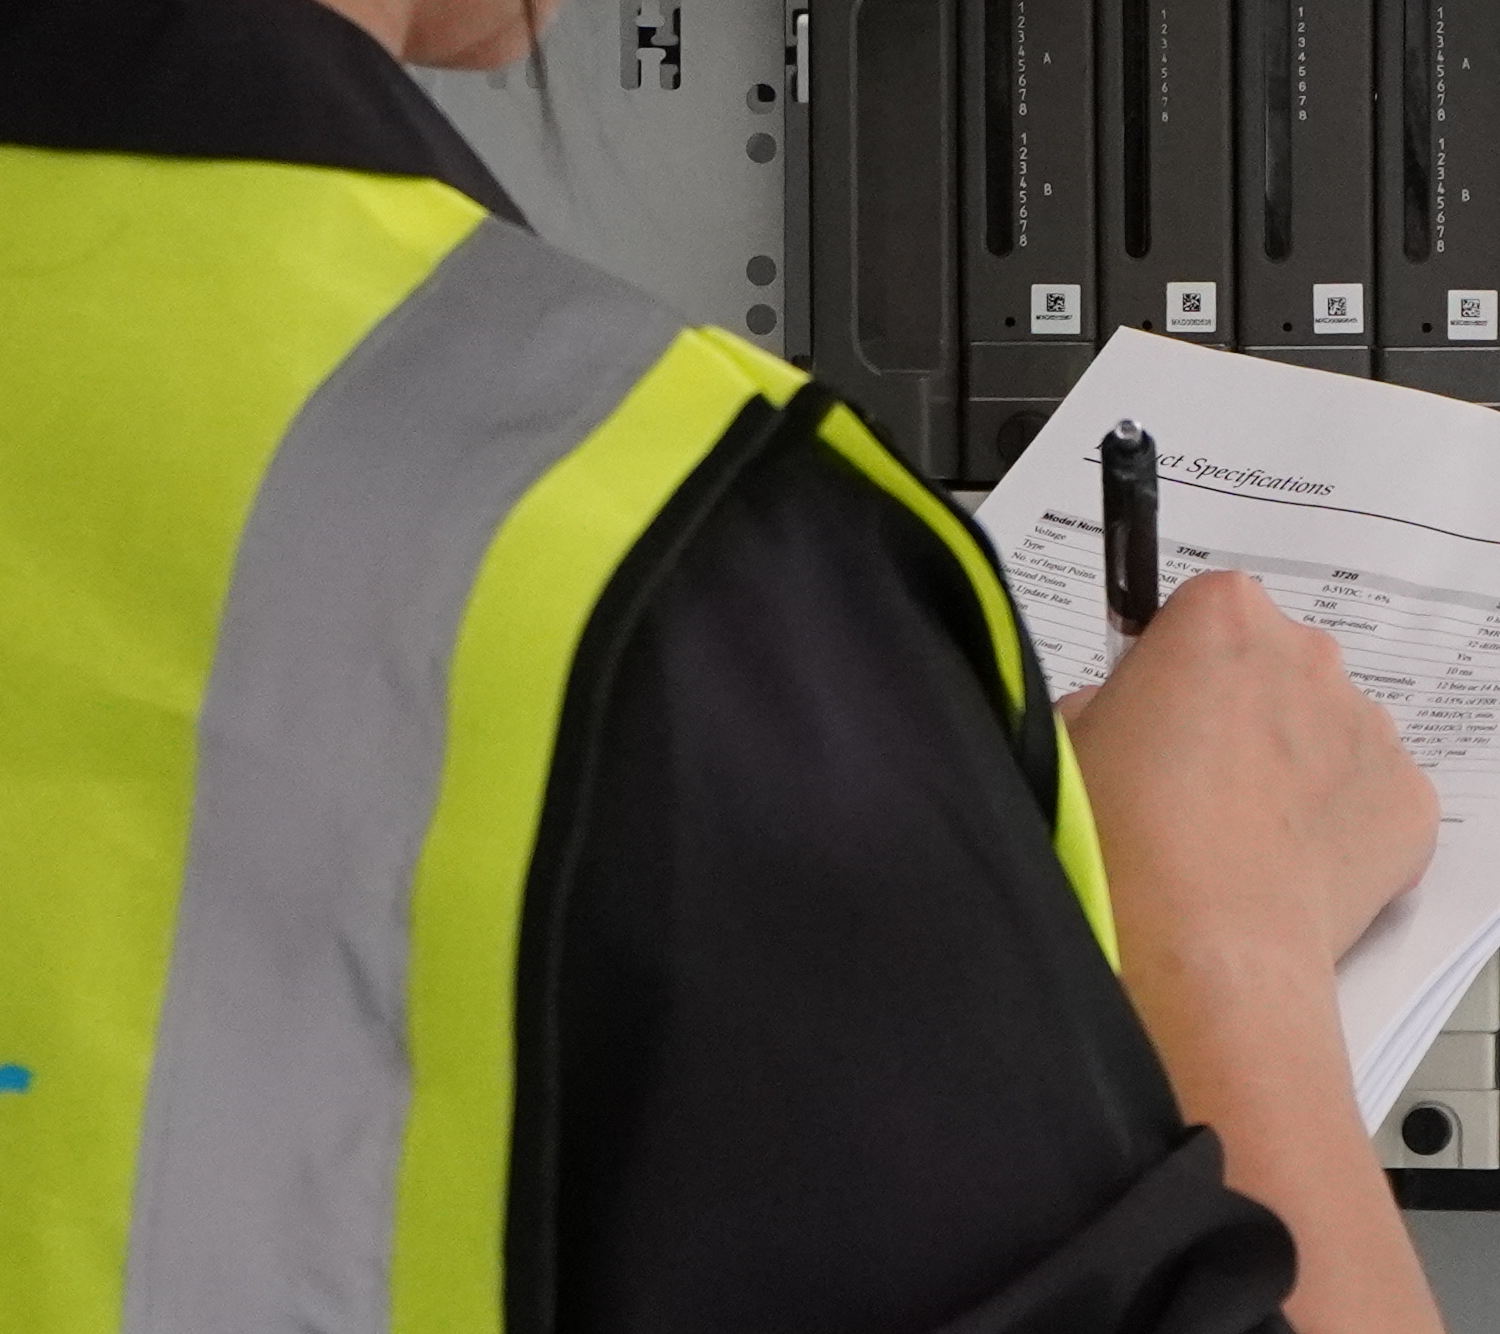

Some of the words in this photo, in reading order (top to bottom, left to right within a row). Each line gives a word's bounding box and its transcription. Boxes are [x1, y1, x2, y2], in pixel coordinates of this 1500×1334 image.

[1018, 1, 1024, 14] 1
[1017, 15, 1026, 29] 2
[1017, 29, 1025, 43] 3
[1017, 44, 1026, 57] 4
[1017, 58, 1026, 72] 5
[1043, 52, 1052, 64] A
[1461, 57, 1471, 70] A
[1018, 73, 1027, 87] 6
[1018, 88, 1027, 101] 7
[1018, 102, 1028, 116] 8
[1043, 182, 1053, 196] B
[1461, 188, 1471, 202] B
[1186, 457, 1336, 496] Specifications
[1042, 512, 1076, 527] Model
[1079, 521, 1105, 535] Num
[1034, 525, 1067, 540] Voltage
[1023, 538, 1045, 551] Type
[1176, 546, 1211, 560] 3704E
[1011, 551, 1029, 563] No.
[1042, 559, 1067, 573] Input
[1069, 565, 1098, 581] Points
[1040, 573, 1067, 588] Points
[1331, 569, 1360, 581] 3720
[1017, 584, 1050, 599] Update
[1052, 592, 1073, 605] Rate
[1314, 599, 1338, 610] TMR
